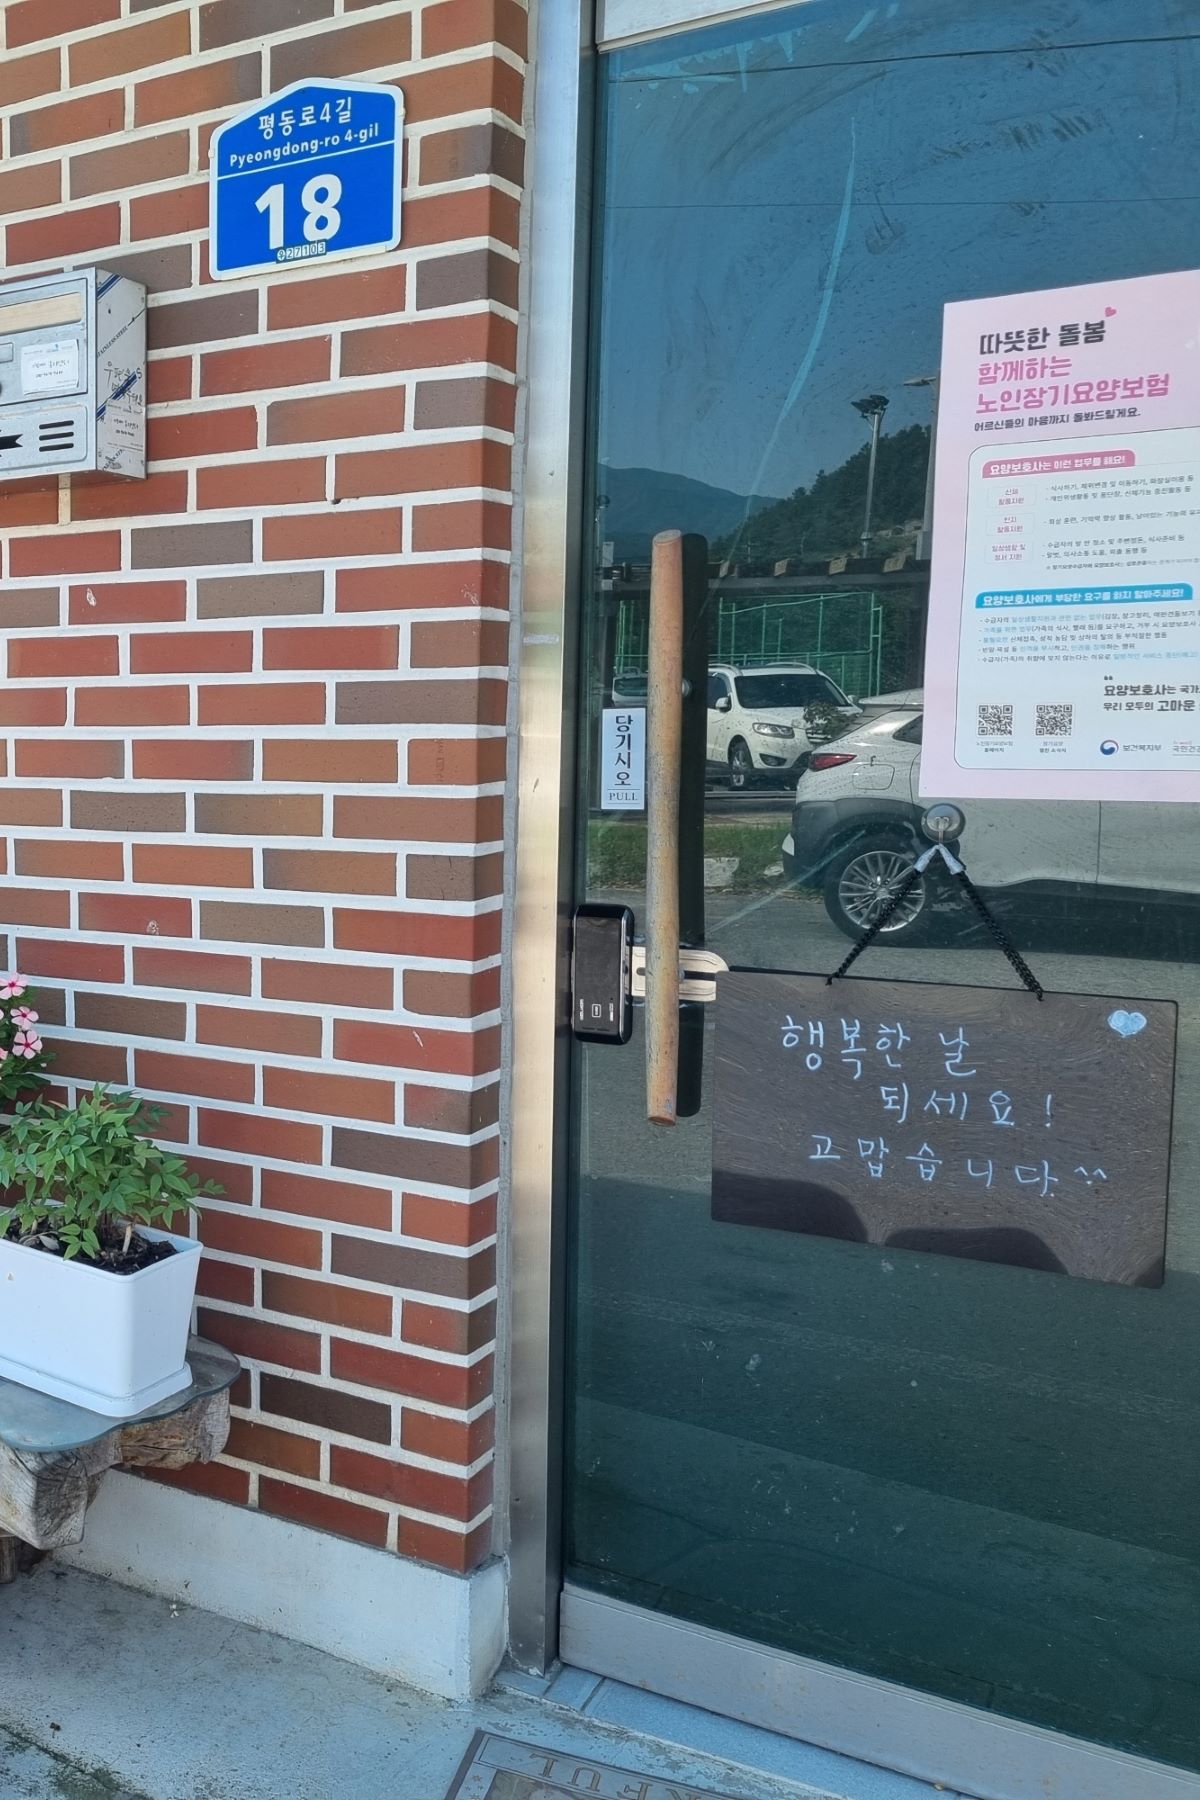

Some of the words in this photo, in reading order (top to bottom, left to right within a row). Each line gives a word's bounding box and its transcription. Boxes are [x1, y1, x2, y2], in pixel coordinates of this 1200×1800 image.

[258, 96, 352, 140] 평동로4길
[230, 134, 340, 169] Pyeongdong-ro
[344, 123, 379, 143] 4-gil
[254, 173, 342, 250] 18
[979, 327, 1050, 355] 따뜻한
[1058, 320, 1106, 347] 돌봄
[978, 356, 1072, 385] 함께하는
[976, 373, 1170, 414] 노인장기요양보험
[974, 418, 1024, 432] 어르신들의
[1028, 413, 1069, 427] 마음까지
[990, 461, 1052, 475] 요양보호사는
[982, 594, 1052, 606] 요양보호사에게
[1103, 702, 1122, 711] 우리
[1125, 702, 1154, 711] 모두의
[1157, 700, 1195, 712] 고마운
[1104, 684, 1176, 696] 요양보호사는
[1180, 685, 1200, 694] 국가
[614, 715, 634, 786] 당기시오
[609, 792, 638, 801] PULL
[781, 1015, 910, 1079] 행복한
[939, 1027, 976, 1077] 날
